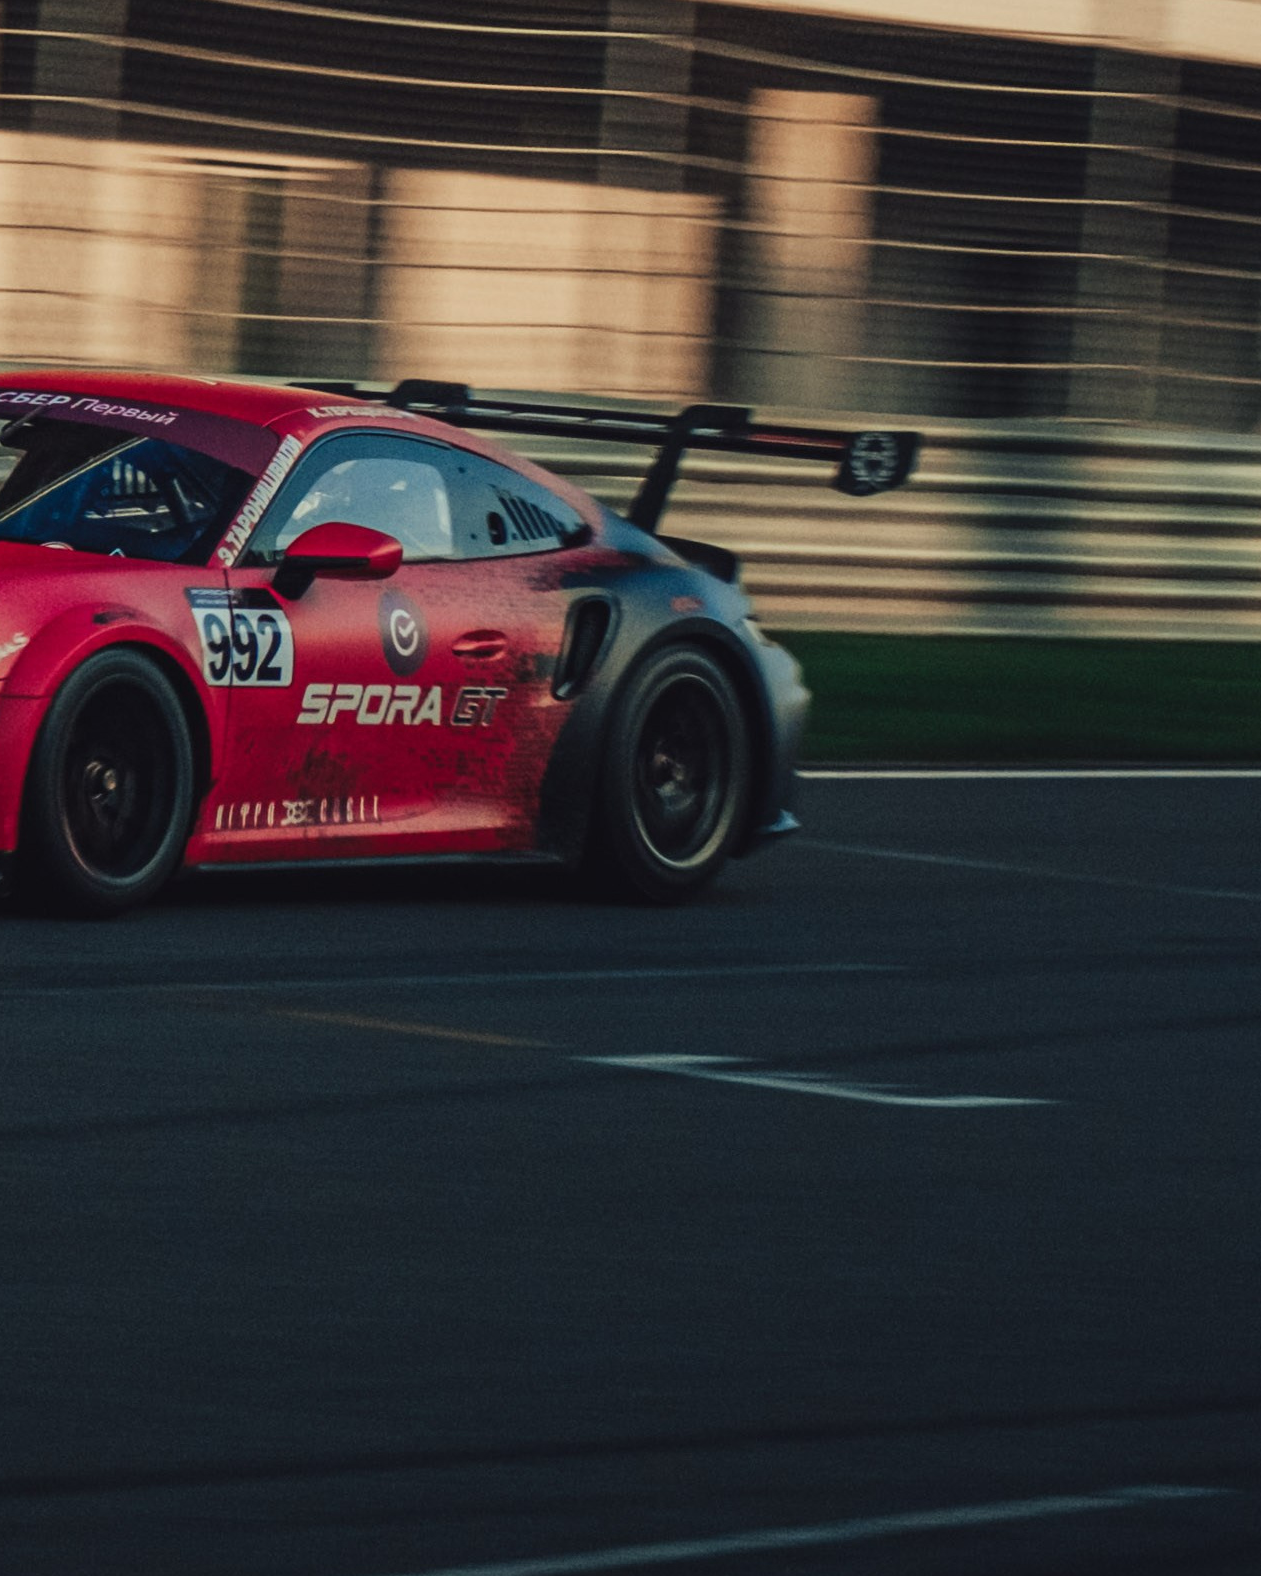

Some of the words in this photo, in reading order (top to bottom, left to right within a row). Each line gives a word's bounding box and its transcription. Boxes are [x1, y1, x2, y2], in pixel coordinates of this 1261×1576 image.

[70, 397, 180, 426] Первый
[203, 613, 282, 682] 992
[296, 683, 442, 726] SPORA
[450, 687, 509, 727] GT
